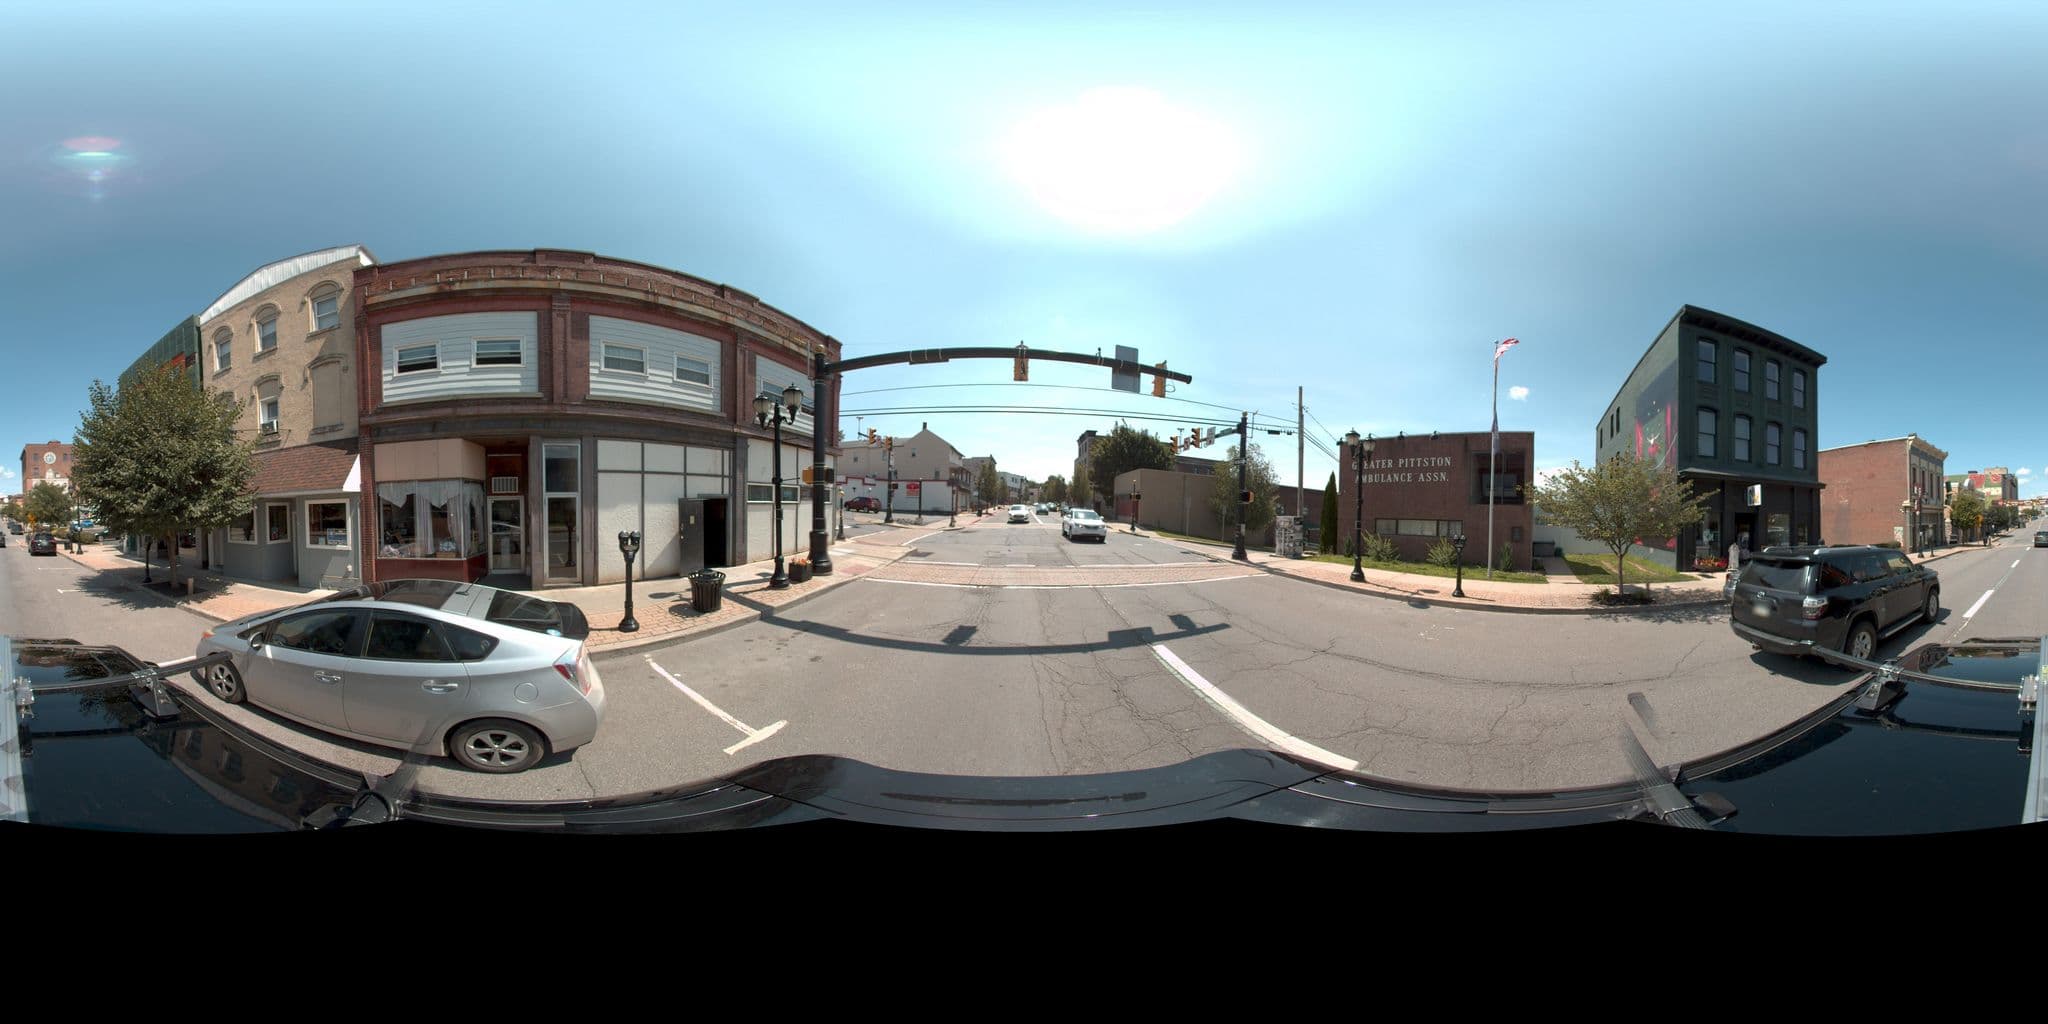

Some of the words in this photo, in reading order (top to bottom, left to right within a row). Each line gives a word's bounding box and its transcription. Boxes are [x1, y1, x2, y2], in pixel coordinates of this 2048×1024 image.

[1352, 459, 1393, 470] GEATER
[1398, 456, 1451, 468] PITTSTON
[1418, 471, 1449, 482] ASSN.
